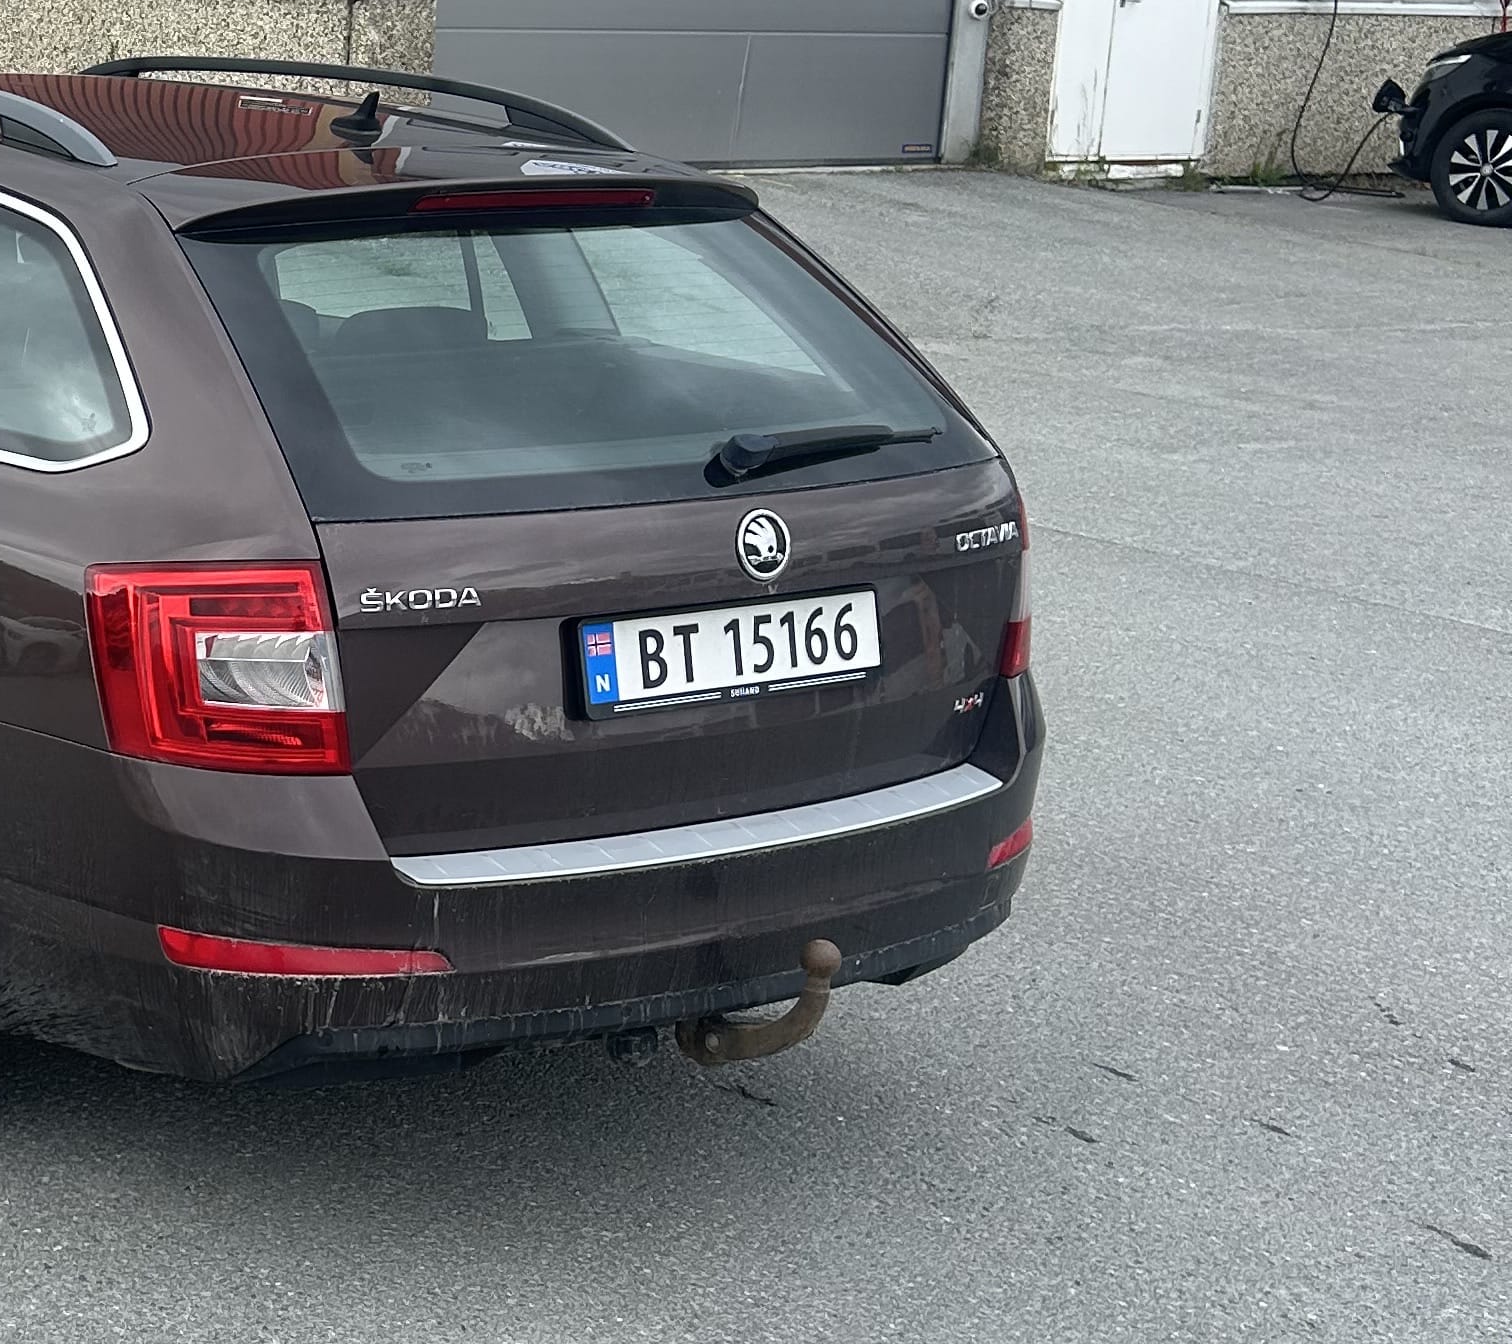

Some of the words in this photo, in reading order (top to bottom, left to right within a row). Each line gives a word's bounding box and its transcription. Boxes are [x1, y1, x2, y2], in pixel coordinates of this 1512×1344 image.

[360, 585, 482, 614] ŠKODA
[638, 623, 700, 690] BT
[723, 602, 860, 676] 15166
[595, 673, 611, 693] N
